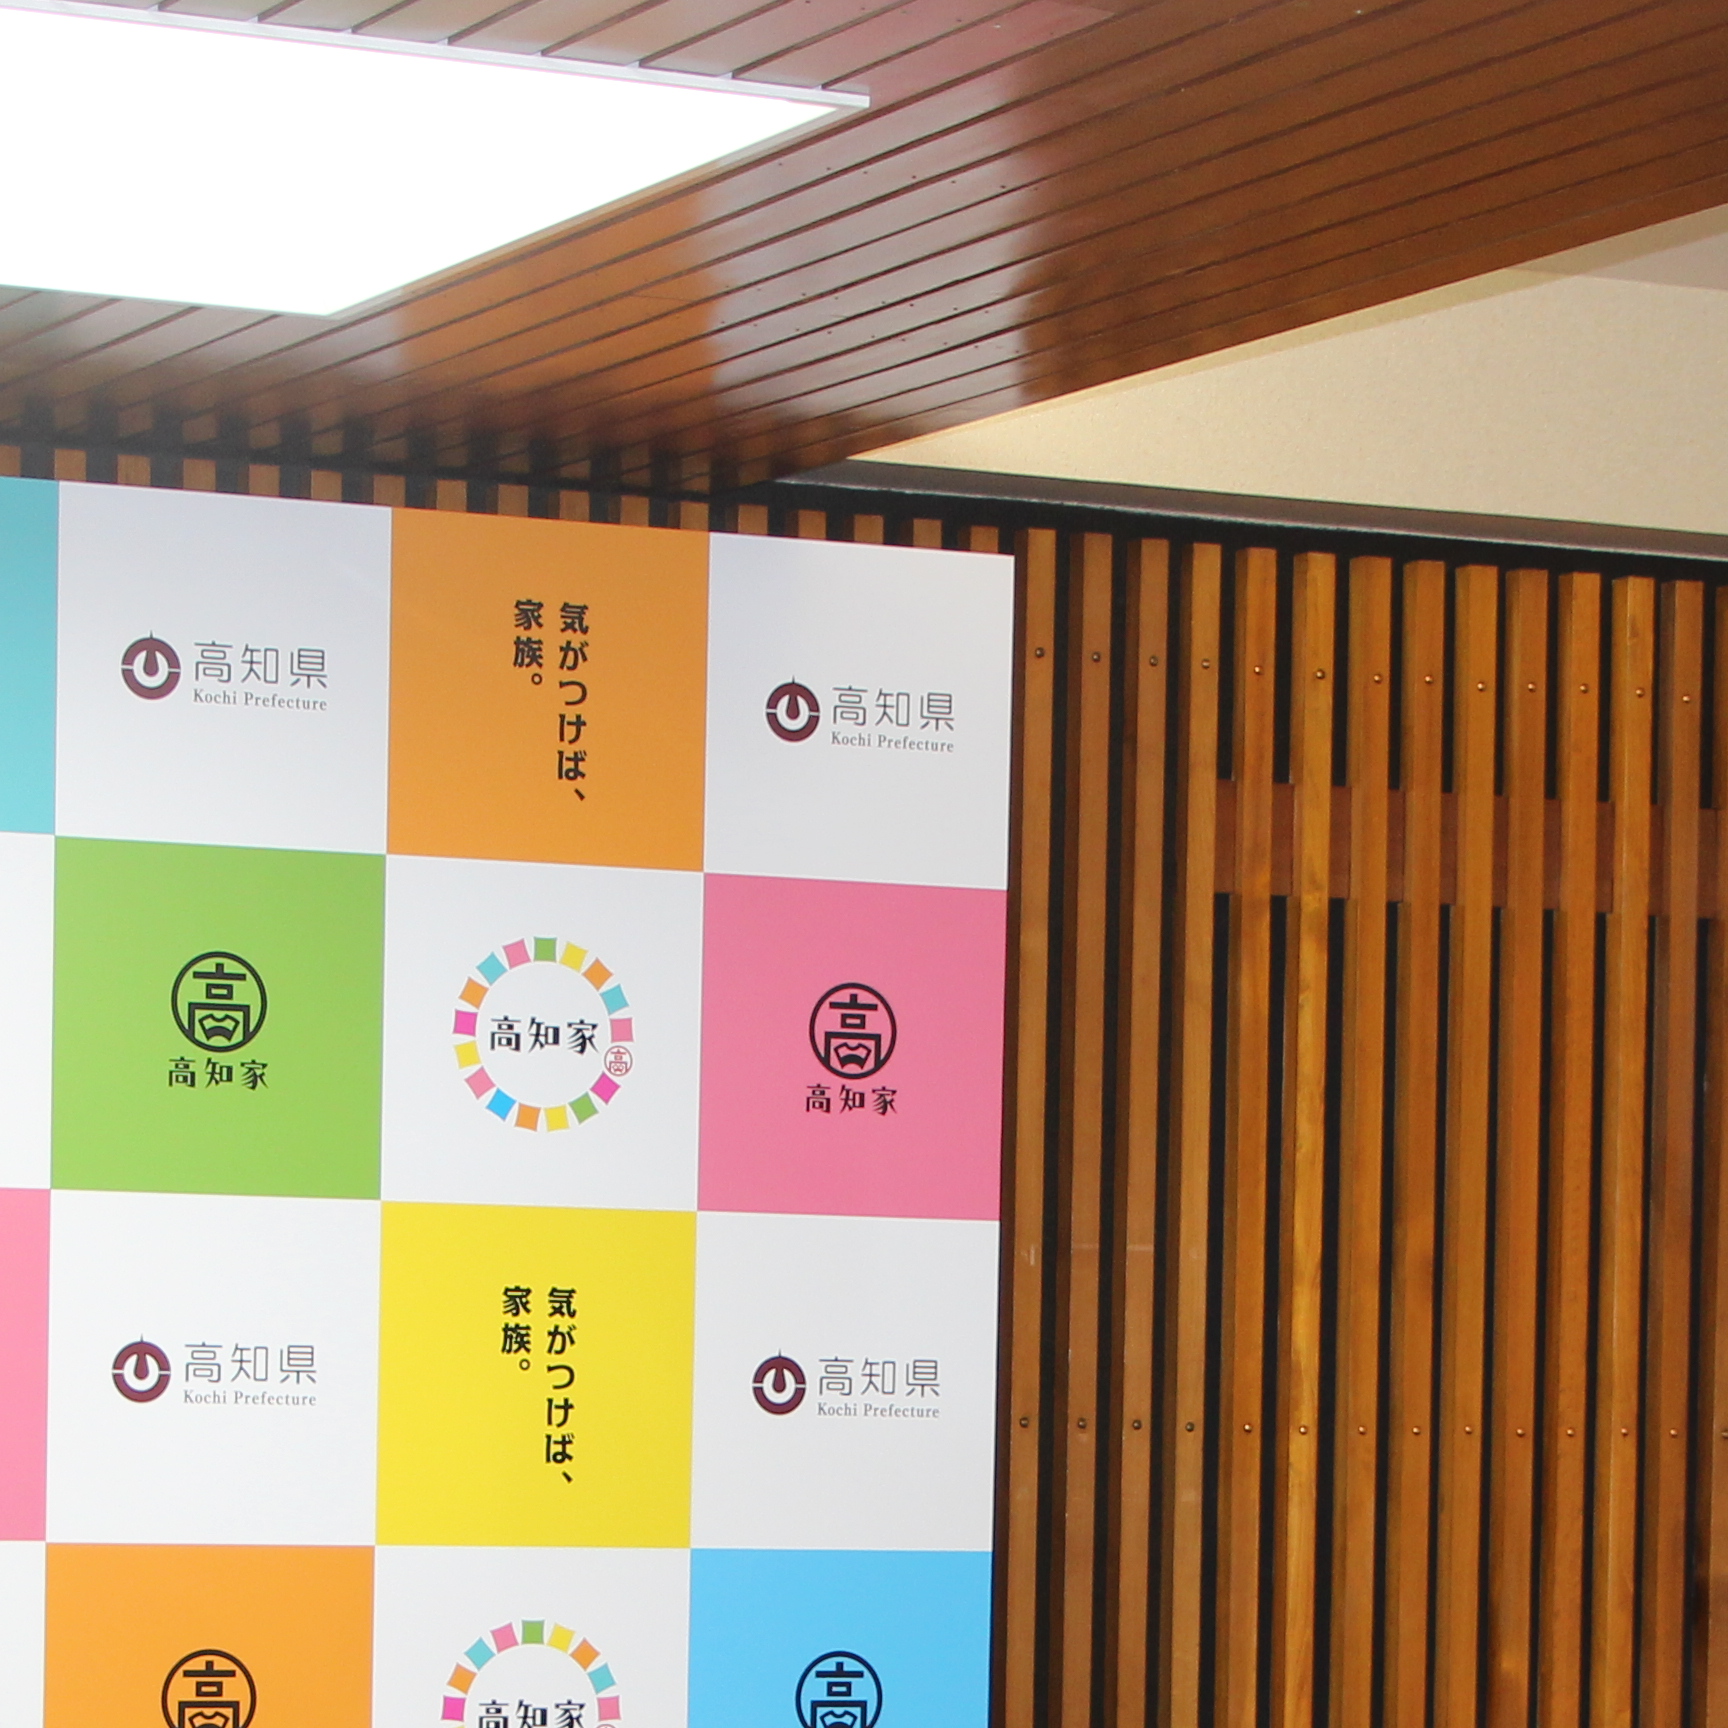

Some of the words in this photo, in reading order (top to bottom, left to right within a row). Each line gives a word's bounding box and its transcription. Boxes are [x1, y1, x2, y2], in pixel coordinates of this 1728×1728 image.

[512, 598, 545, 686] 家族。
[194, 640, 328, 689] 高知県
[193, 688, 237, 705] Kochi
[243, 691, 327, 711] Prefecture
[557, 601, 590, 802] 気がつけば、
[832, 685, 955, 732] 高知県
[831, 730, 872, 747] Kochi
[877, 733, 954, 753] Prefecture
[185, 960, 253, 1045] 高
[490, 1015, 598, 1055] 高知家
[822, 991, 884, 1073] 高
[168, 1055, 268, 1091] 高知家
[805, 1083, 898, 1117] 高知家
[501, 1285, 533, 1371] 家族。
[184, 1341, 317, 1385] 高知県
[545, 1286, 577, 1483] 気がつけば、
[818, 1356, 941, 1398] 高知県
[183, 1389, 227, 1405] Kochi
[233, 1390, 317, 1407] Prefecture
[817, 1401, 858, 1417] Kochi
[863, 1402, 940, 1419] Prefecture
